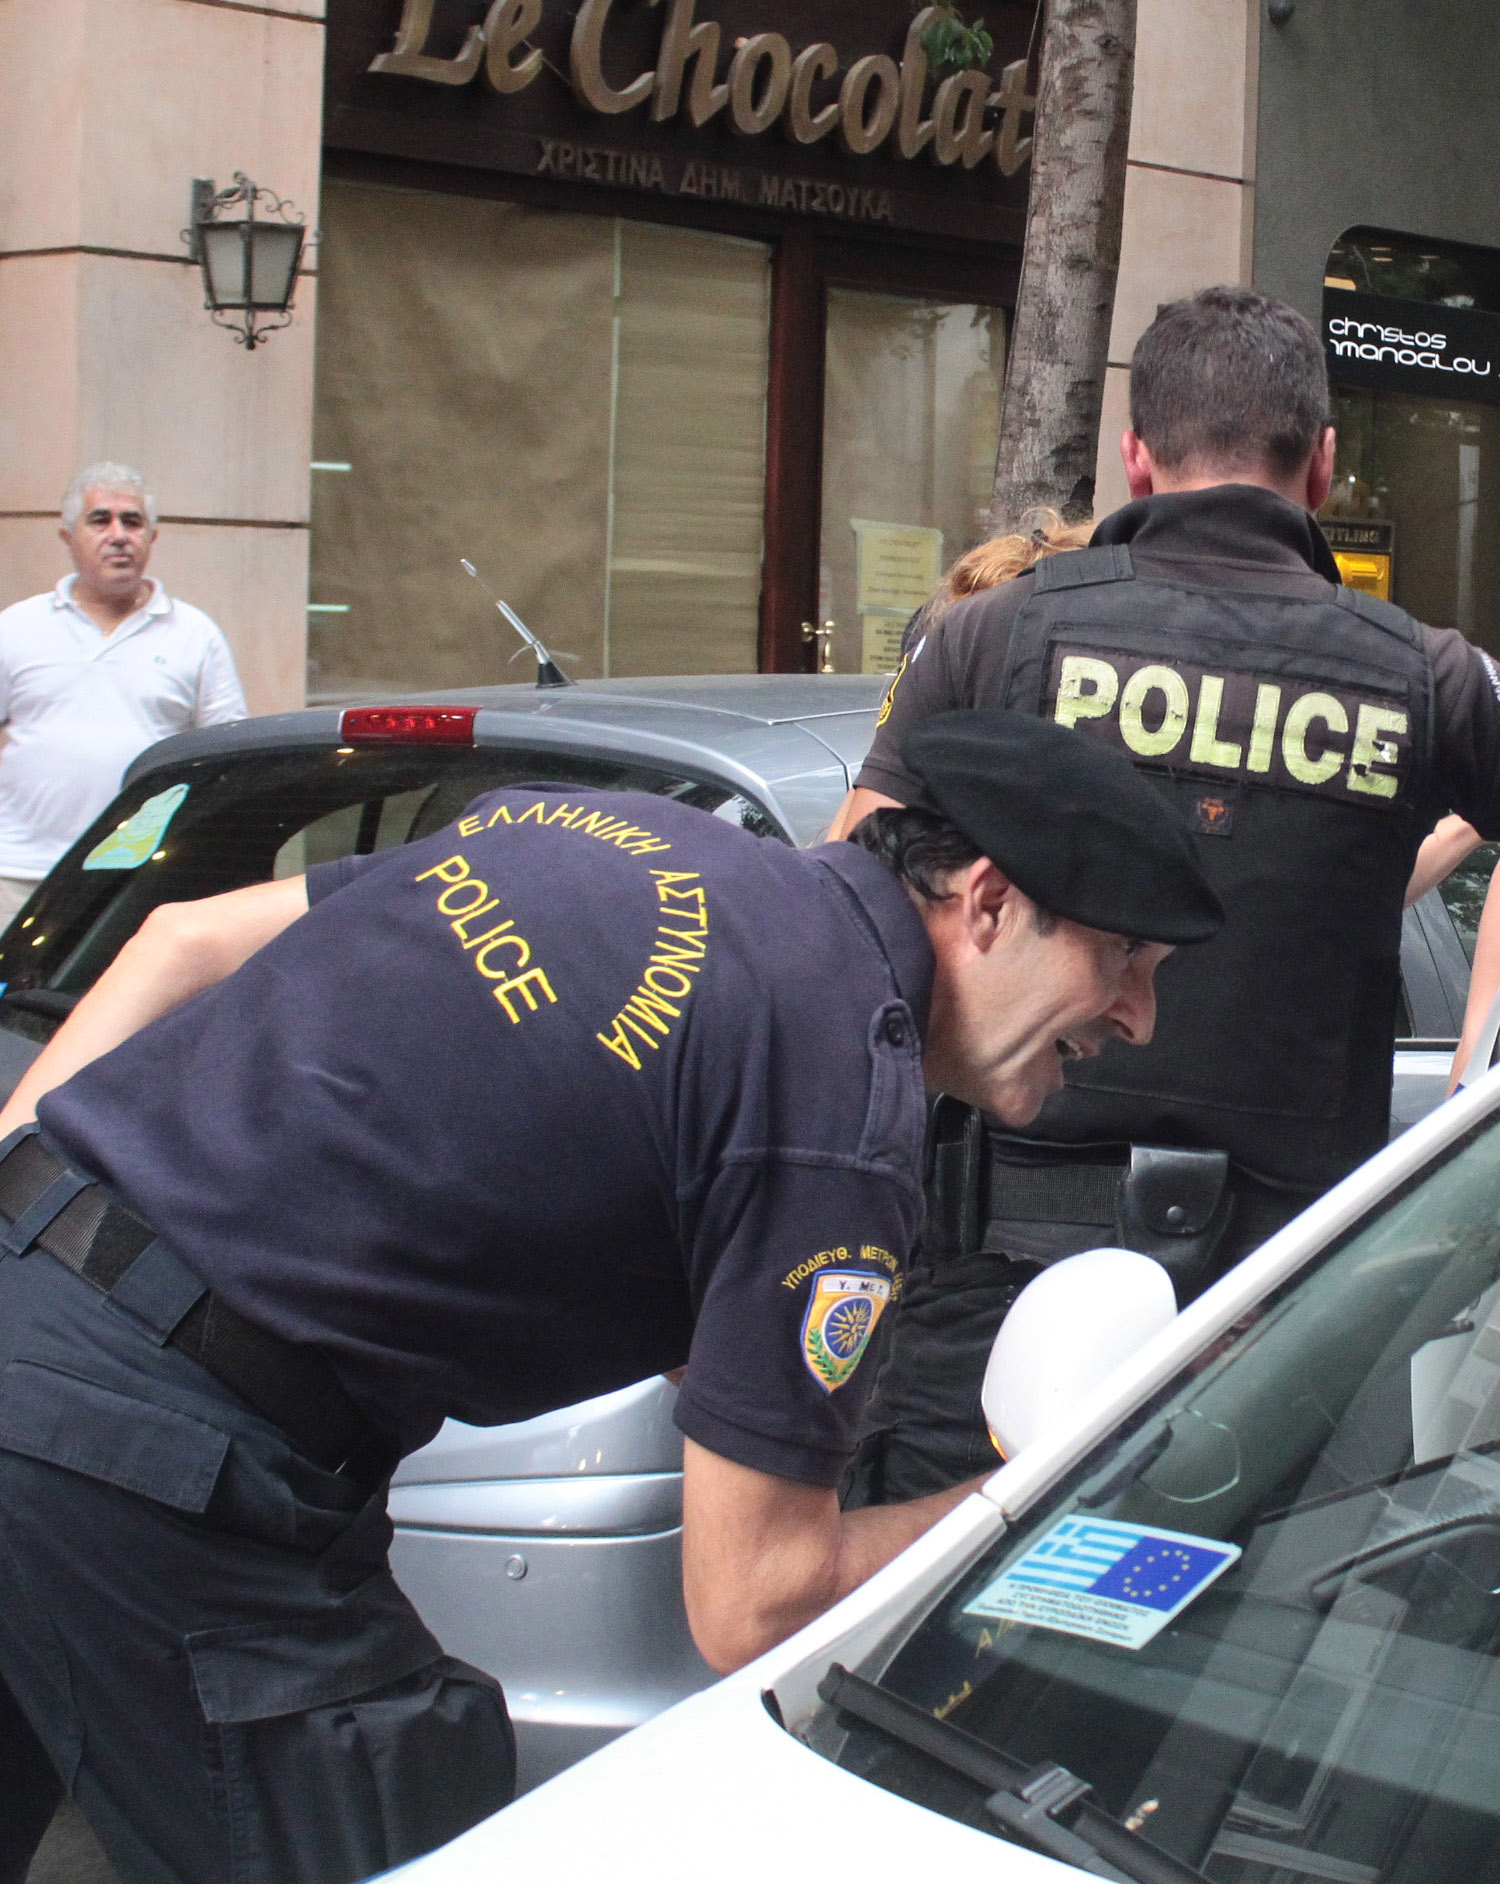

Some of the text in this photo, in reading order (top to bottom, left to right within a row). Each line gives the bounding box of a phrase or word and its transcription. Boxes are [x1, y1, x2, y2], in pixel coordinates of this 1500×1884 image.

[367, 0, 1035, 176] Le Chocolat
[537, 139, 665, 192] ΧΡΙΣΤΙΝΑ
[759, 174, 896, 222] ΜΑΤΣΟΥΚΑ
[1054, 655, 1408, 799] POLICE
[414, 854, 558, 1025] POLICE
[458, 801, 709, 1070] ΕΛΛΗΝΙΚΗ ΑΣΤΥΝΟΜΙΑ
